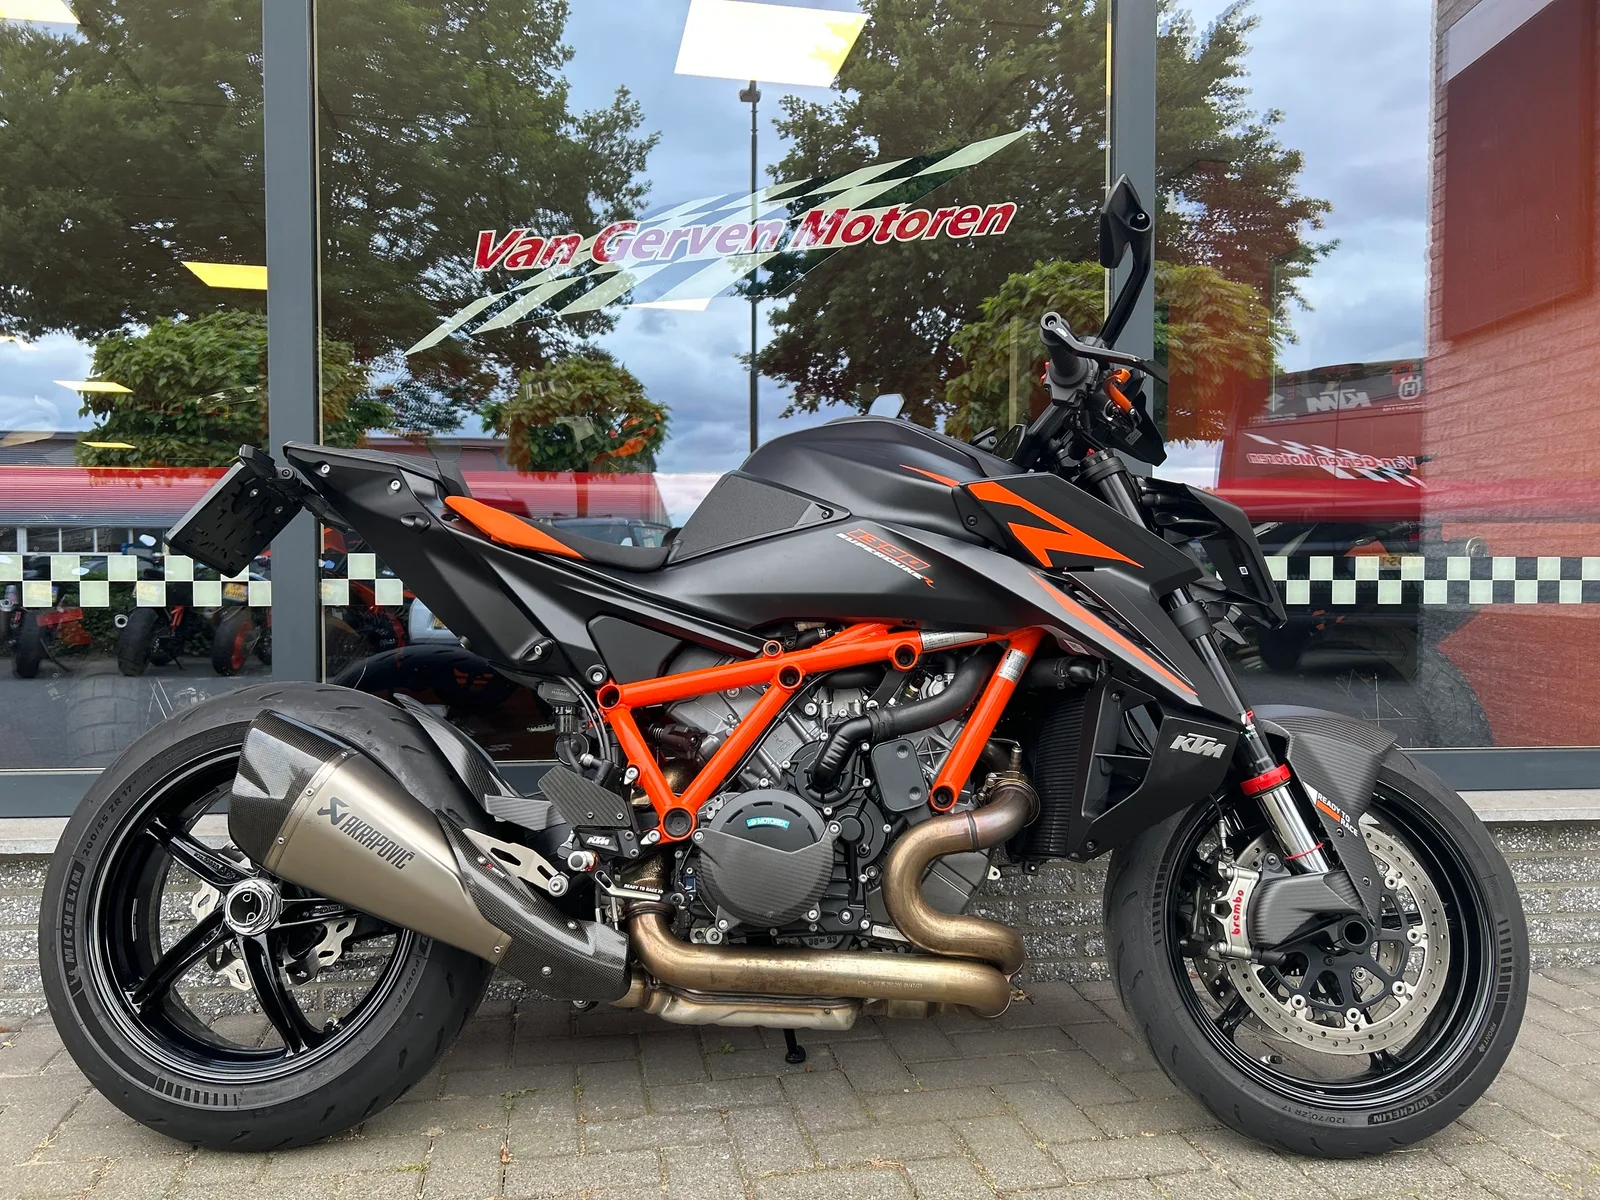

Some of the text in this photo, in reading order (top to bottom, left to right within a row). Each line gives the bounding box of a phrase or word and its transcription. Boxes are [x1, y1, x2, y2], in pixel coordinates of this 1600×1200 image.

[474, 202, 1017, 271] Van Gerven Motoren
[1169, 732, 1227, 759] KTM
[82, 784, 133, 857] 200/55 ZR 17
[1317, 792, 1351, 823] READY TO
[586, 835, 611, 846] KTM
[1340, 817, 1359, 837] RACE
[64, 868, 83, 964] MICHELIN
[1231, 889, 1244, 936] brembo
[397, 958, 420, 1004] POWER
[1483, 1021, 1498, 1046] FRONT
[1281, 1105, 1346, 1124] 120/70 ZR 17
[1373, 1098, 1430, 1123] MICHELIN
